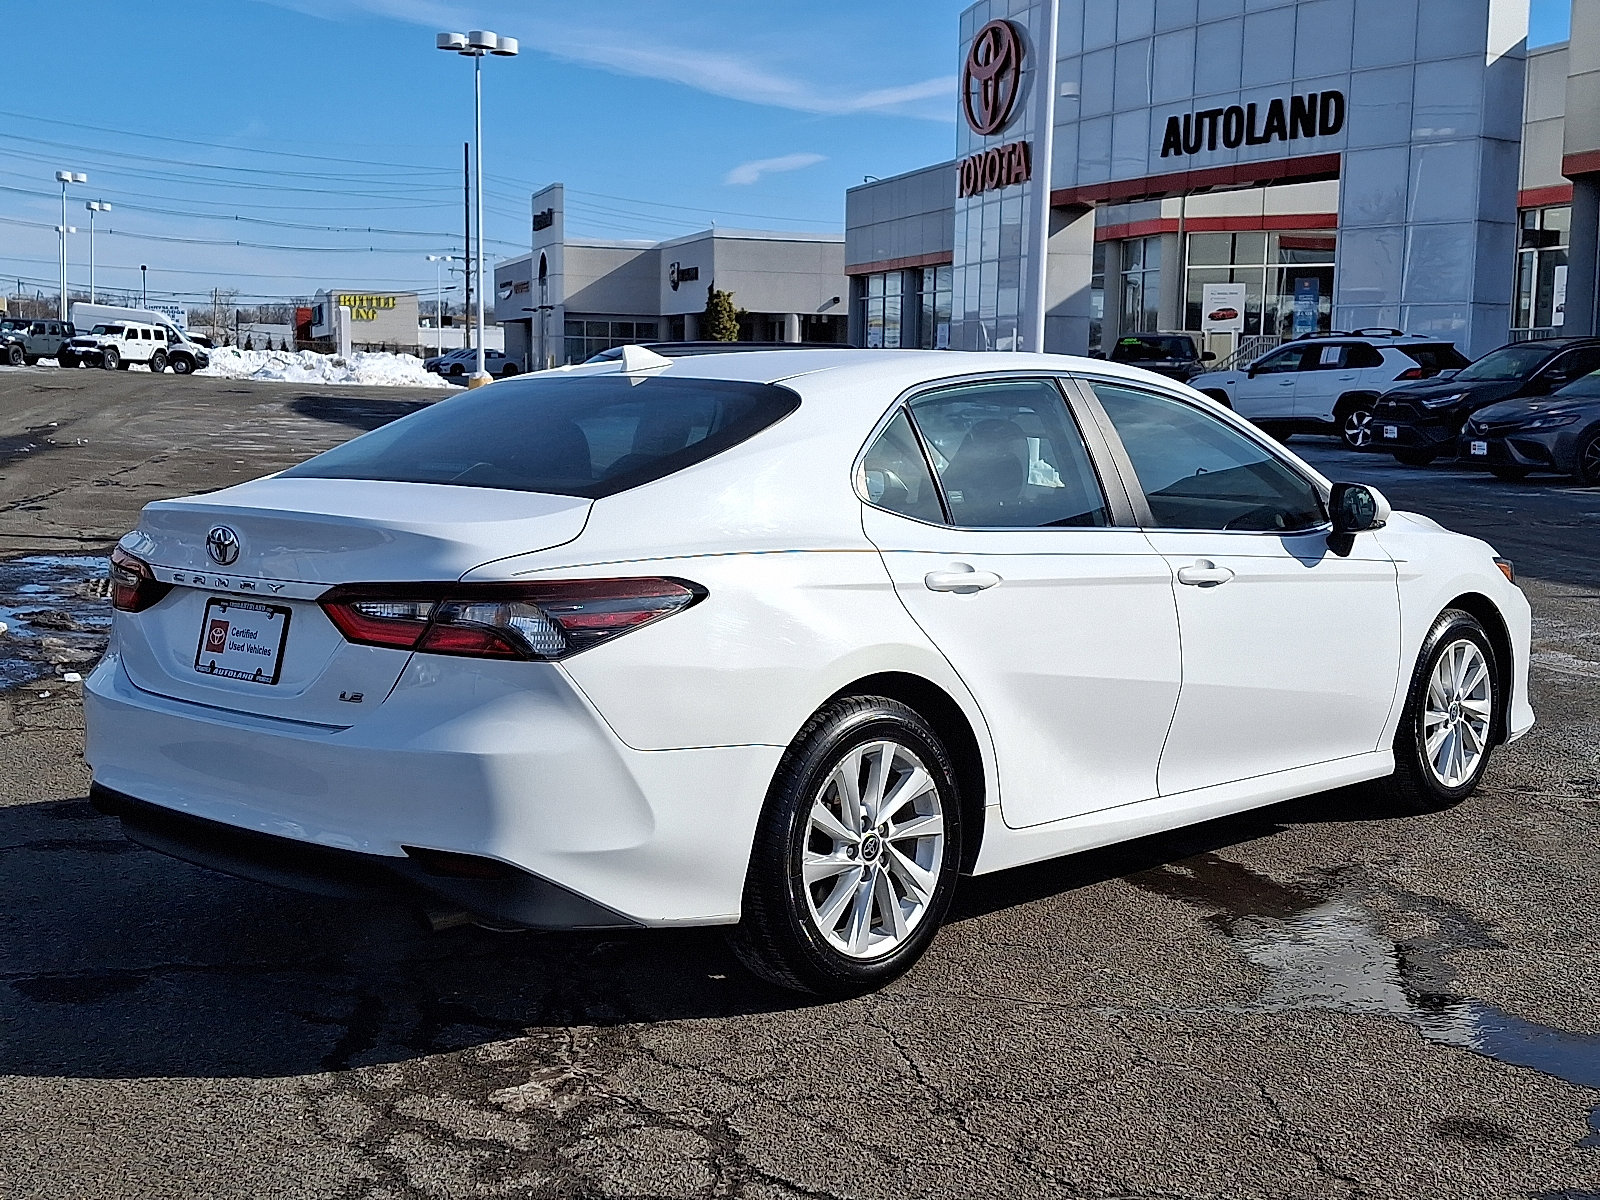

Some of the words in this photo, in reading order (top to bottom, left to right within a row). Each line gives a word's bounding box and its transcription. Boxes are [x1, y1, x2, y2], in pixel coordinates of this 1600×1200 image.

[1160, 90, 1345, 157] AUTOLAND
[956, 141, 1031, 198] TOYOTA
[350, 306, 376, 321] ING
[173, 573, 285, 593] CAMRY
[231, 627, 258, 640] Certified
[228, 640, 246, 653] Used
[246, 642, 272, 657] Vehicles
[213, 667, 254, 681] AUTOLAND
[339, 690, 364, 703] LE
